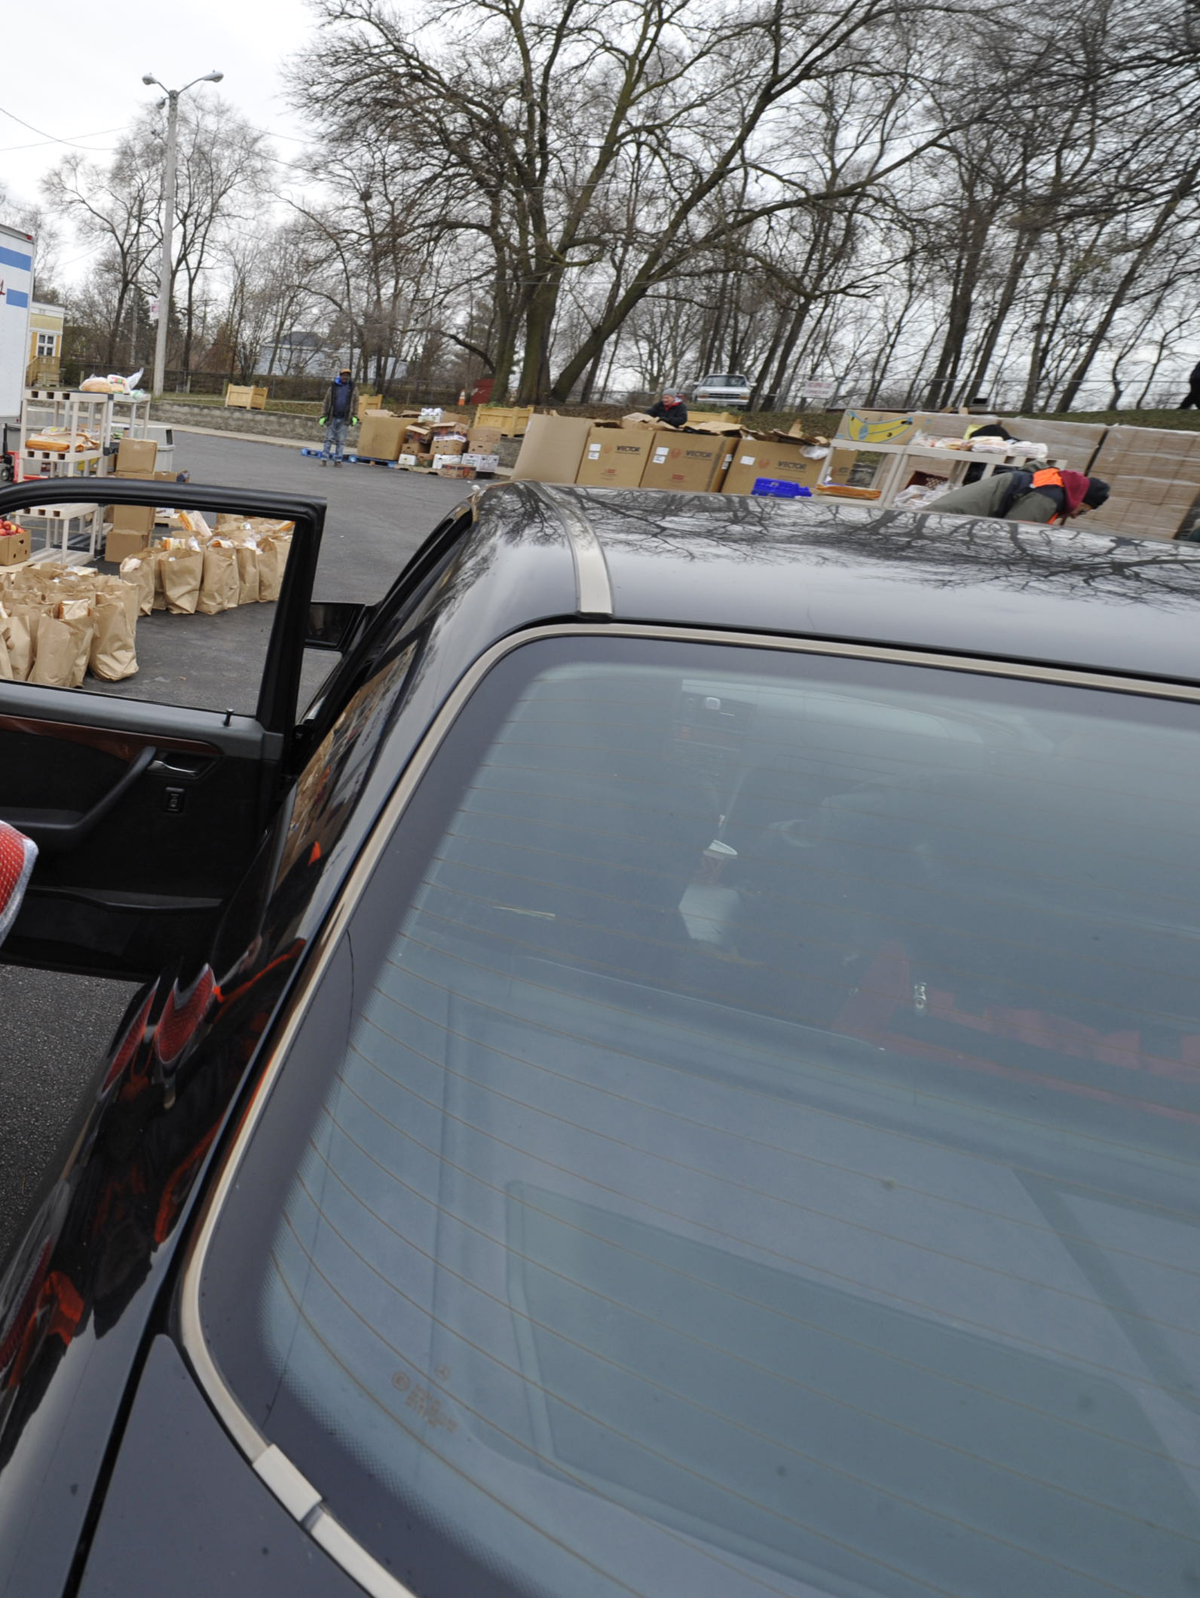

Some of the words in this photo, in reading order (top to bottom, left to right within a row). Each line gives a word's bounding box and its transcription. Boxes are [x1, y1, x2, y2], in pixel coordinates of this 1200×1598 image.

[616, 445, 641, 453] VECTOR
[685, 450, 713, 459] VECTOR
[778, 460, 807, 470] VECTOR
